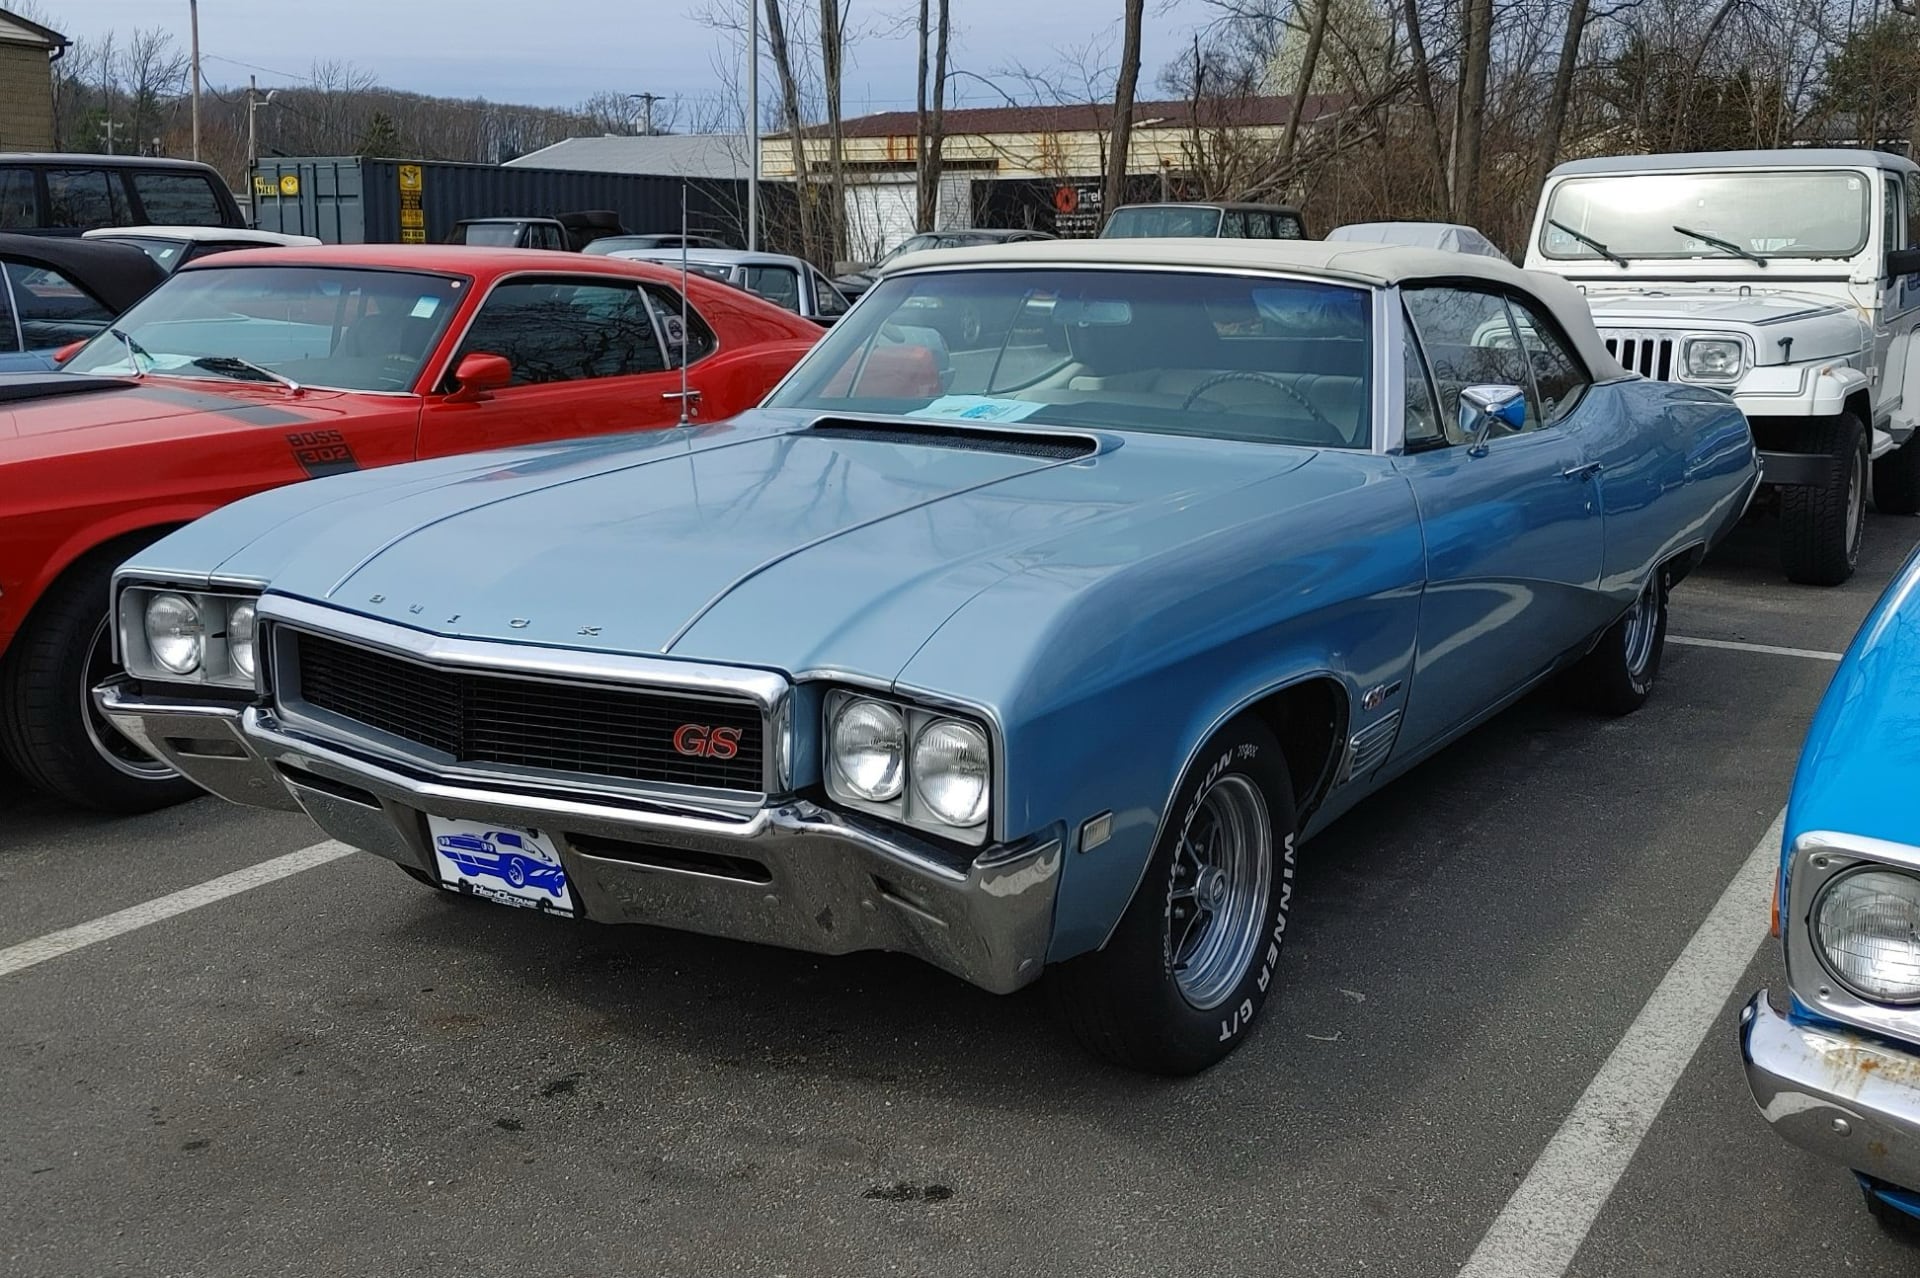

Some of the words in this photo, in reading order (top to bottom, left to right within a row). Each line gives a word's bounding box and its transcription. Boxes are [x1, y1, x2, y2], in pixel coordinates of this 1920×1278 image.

[286, 430, 344, 447] BOSS
[302, 446, 347, 462] 302
[369, 594, 602, 636] BUICK
[673, 723, 743, 760] GS
[1259, 832, 1295, 992] WINNER
[1219, 998, 1253, 1042] G/T
